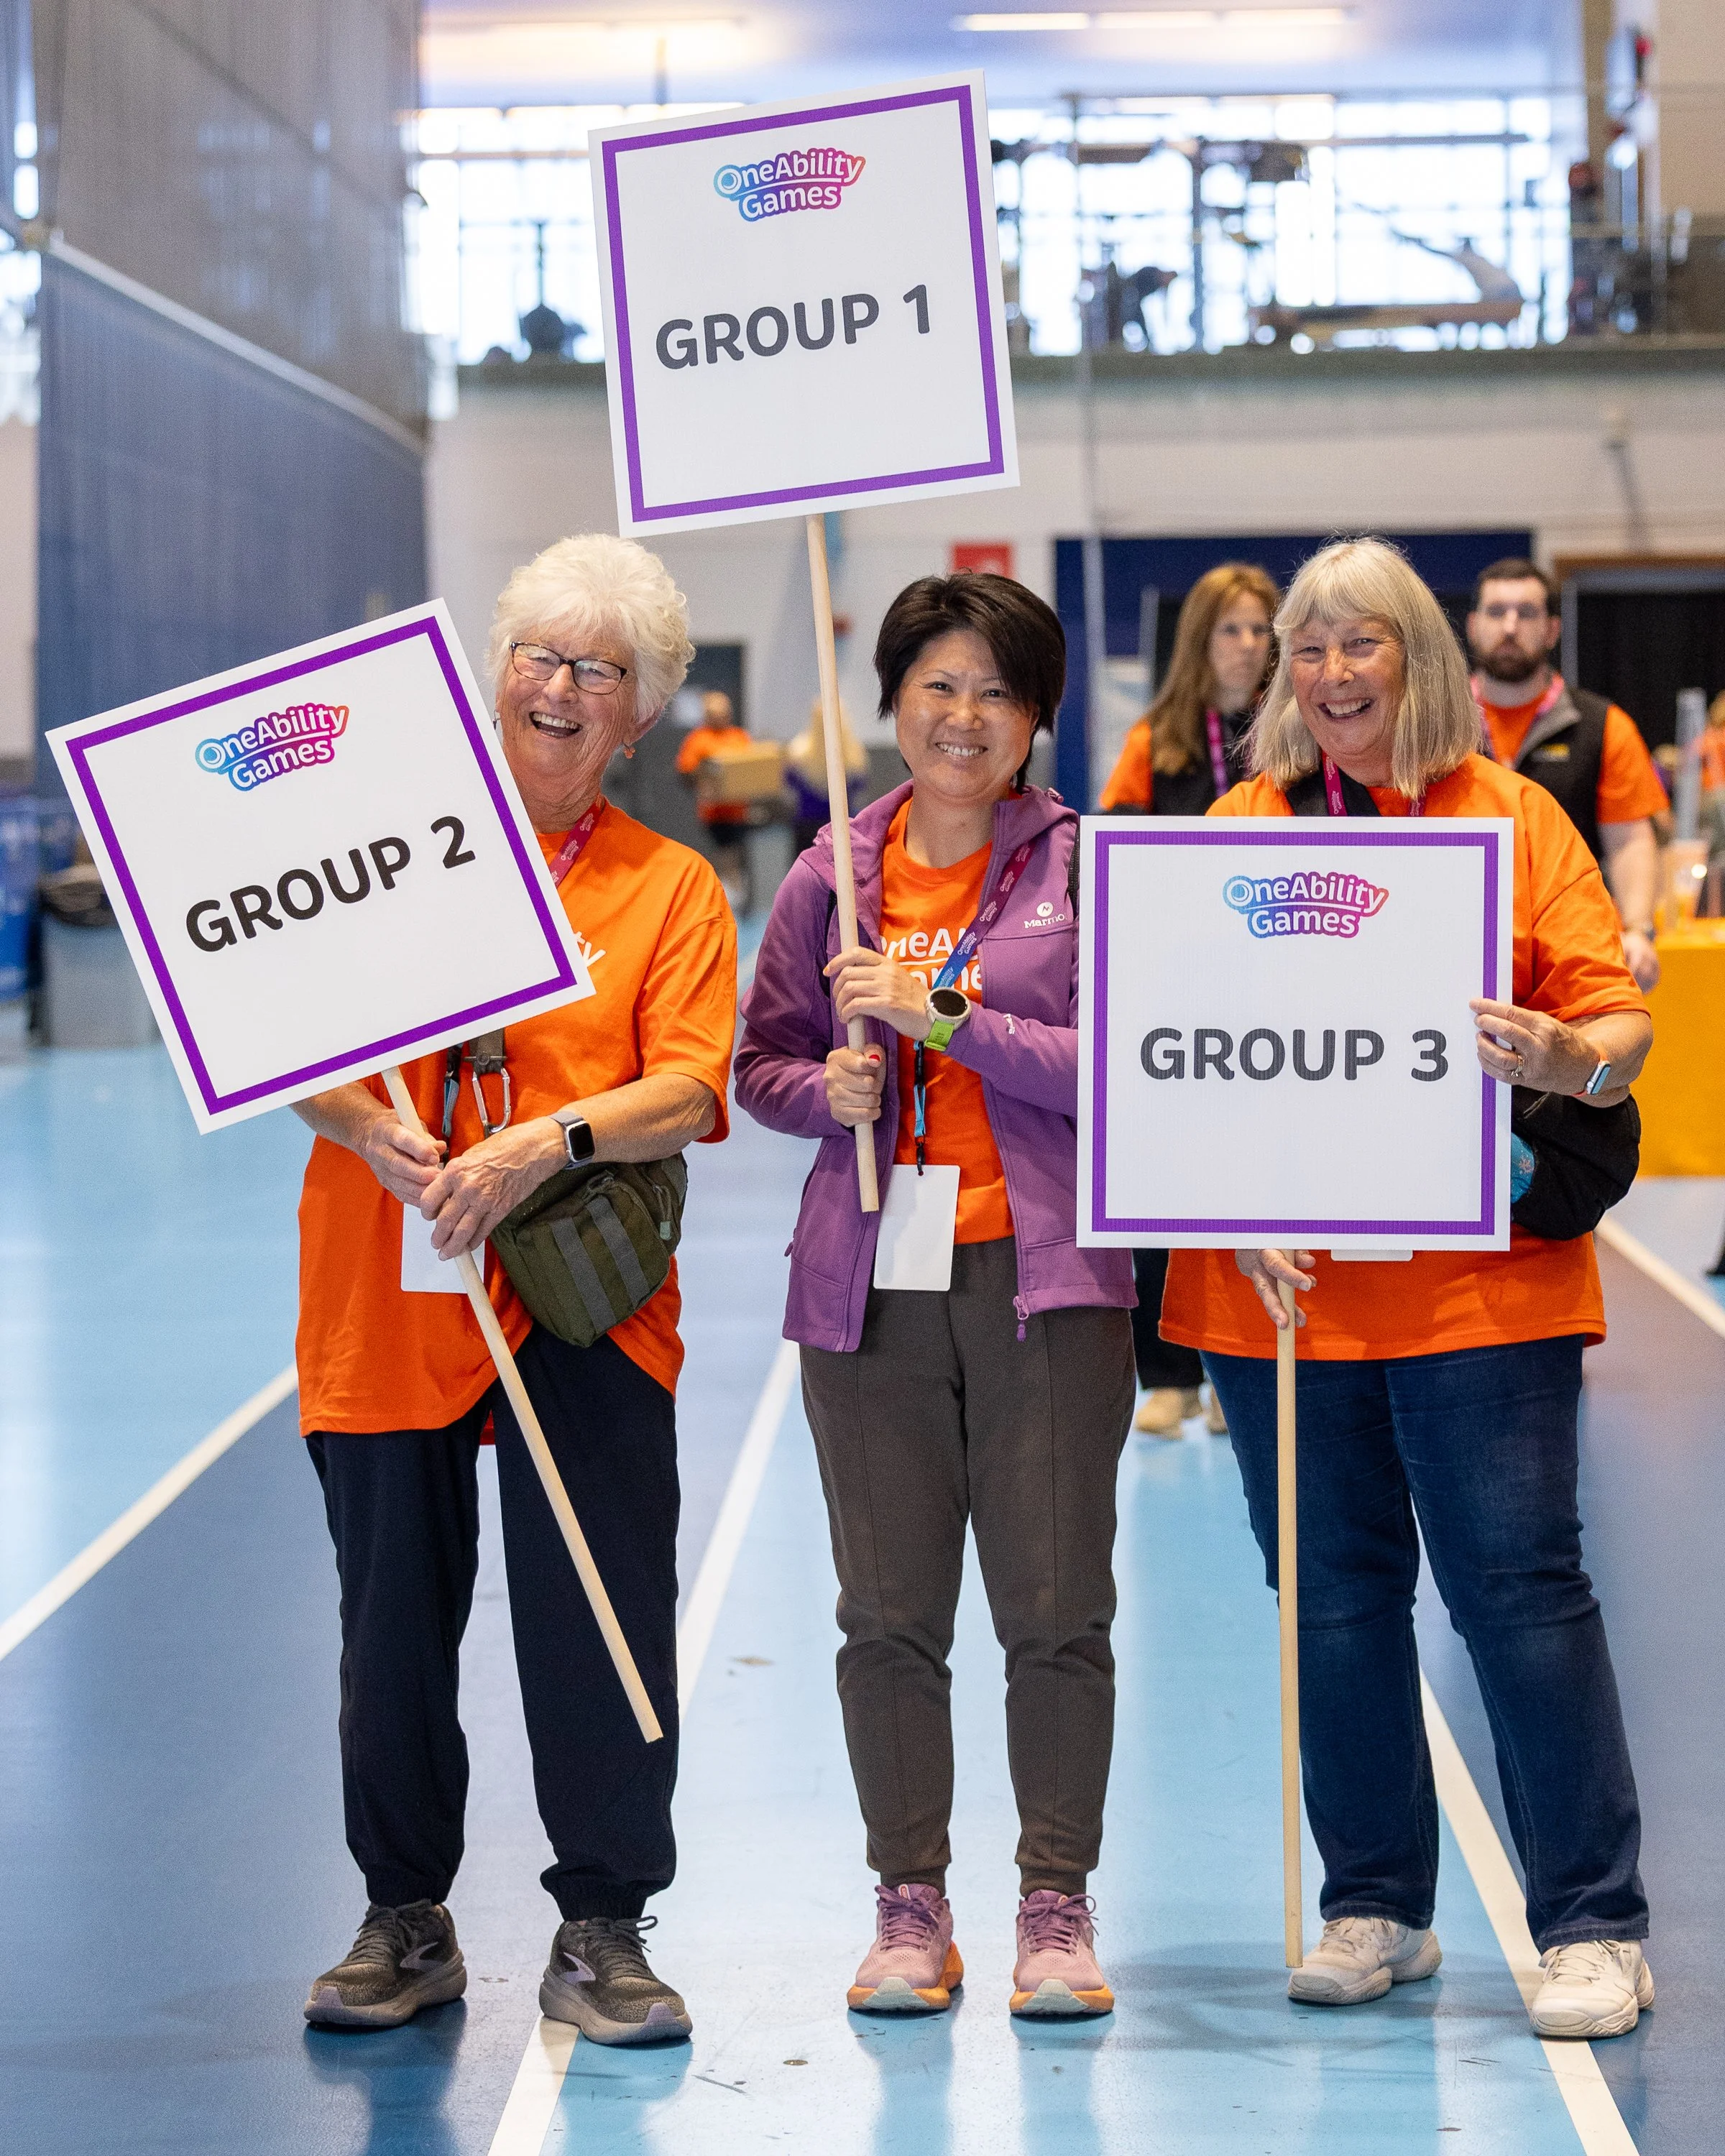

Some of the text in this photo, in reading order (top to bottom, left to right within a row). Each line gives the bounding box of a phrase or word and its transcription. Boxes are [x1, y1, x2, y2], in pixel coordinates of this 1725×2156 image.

[717, 150, 862, 195] OneAbility
[742, 185, 839, 218] Games
[656, 284, 930, 369] GROUP 1
[198, 706, 346, 770] OneAbility
[231, 739, 331, 788] Games
[185, 816, 476, 952] GROUP 2
[1226, 875, 1384, 913] OneAbility
[1251, 909, 1356, 935] Games
[1140, 1027, 1449, 1082] GROUP 3
